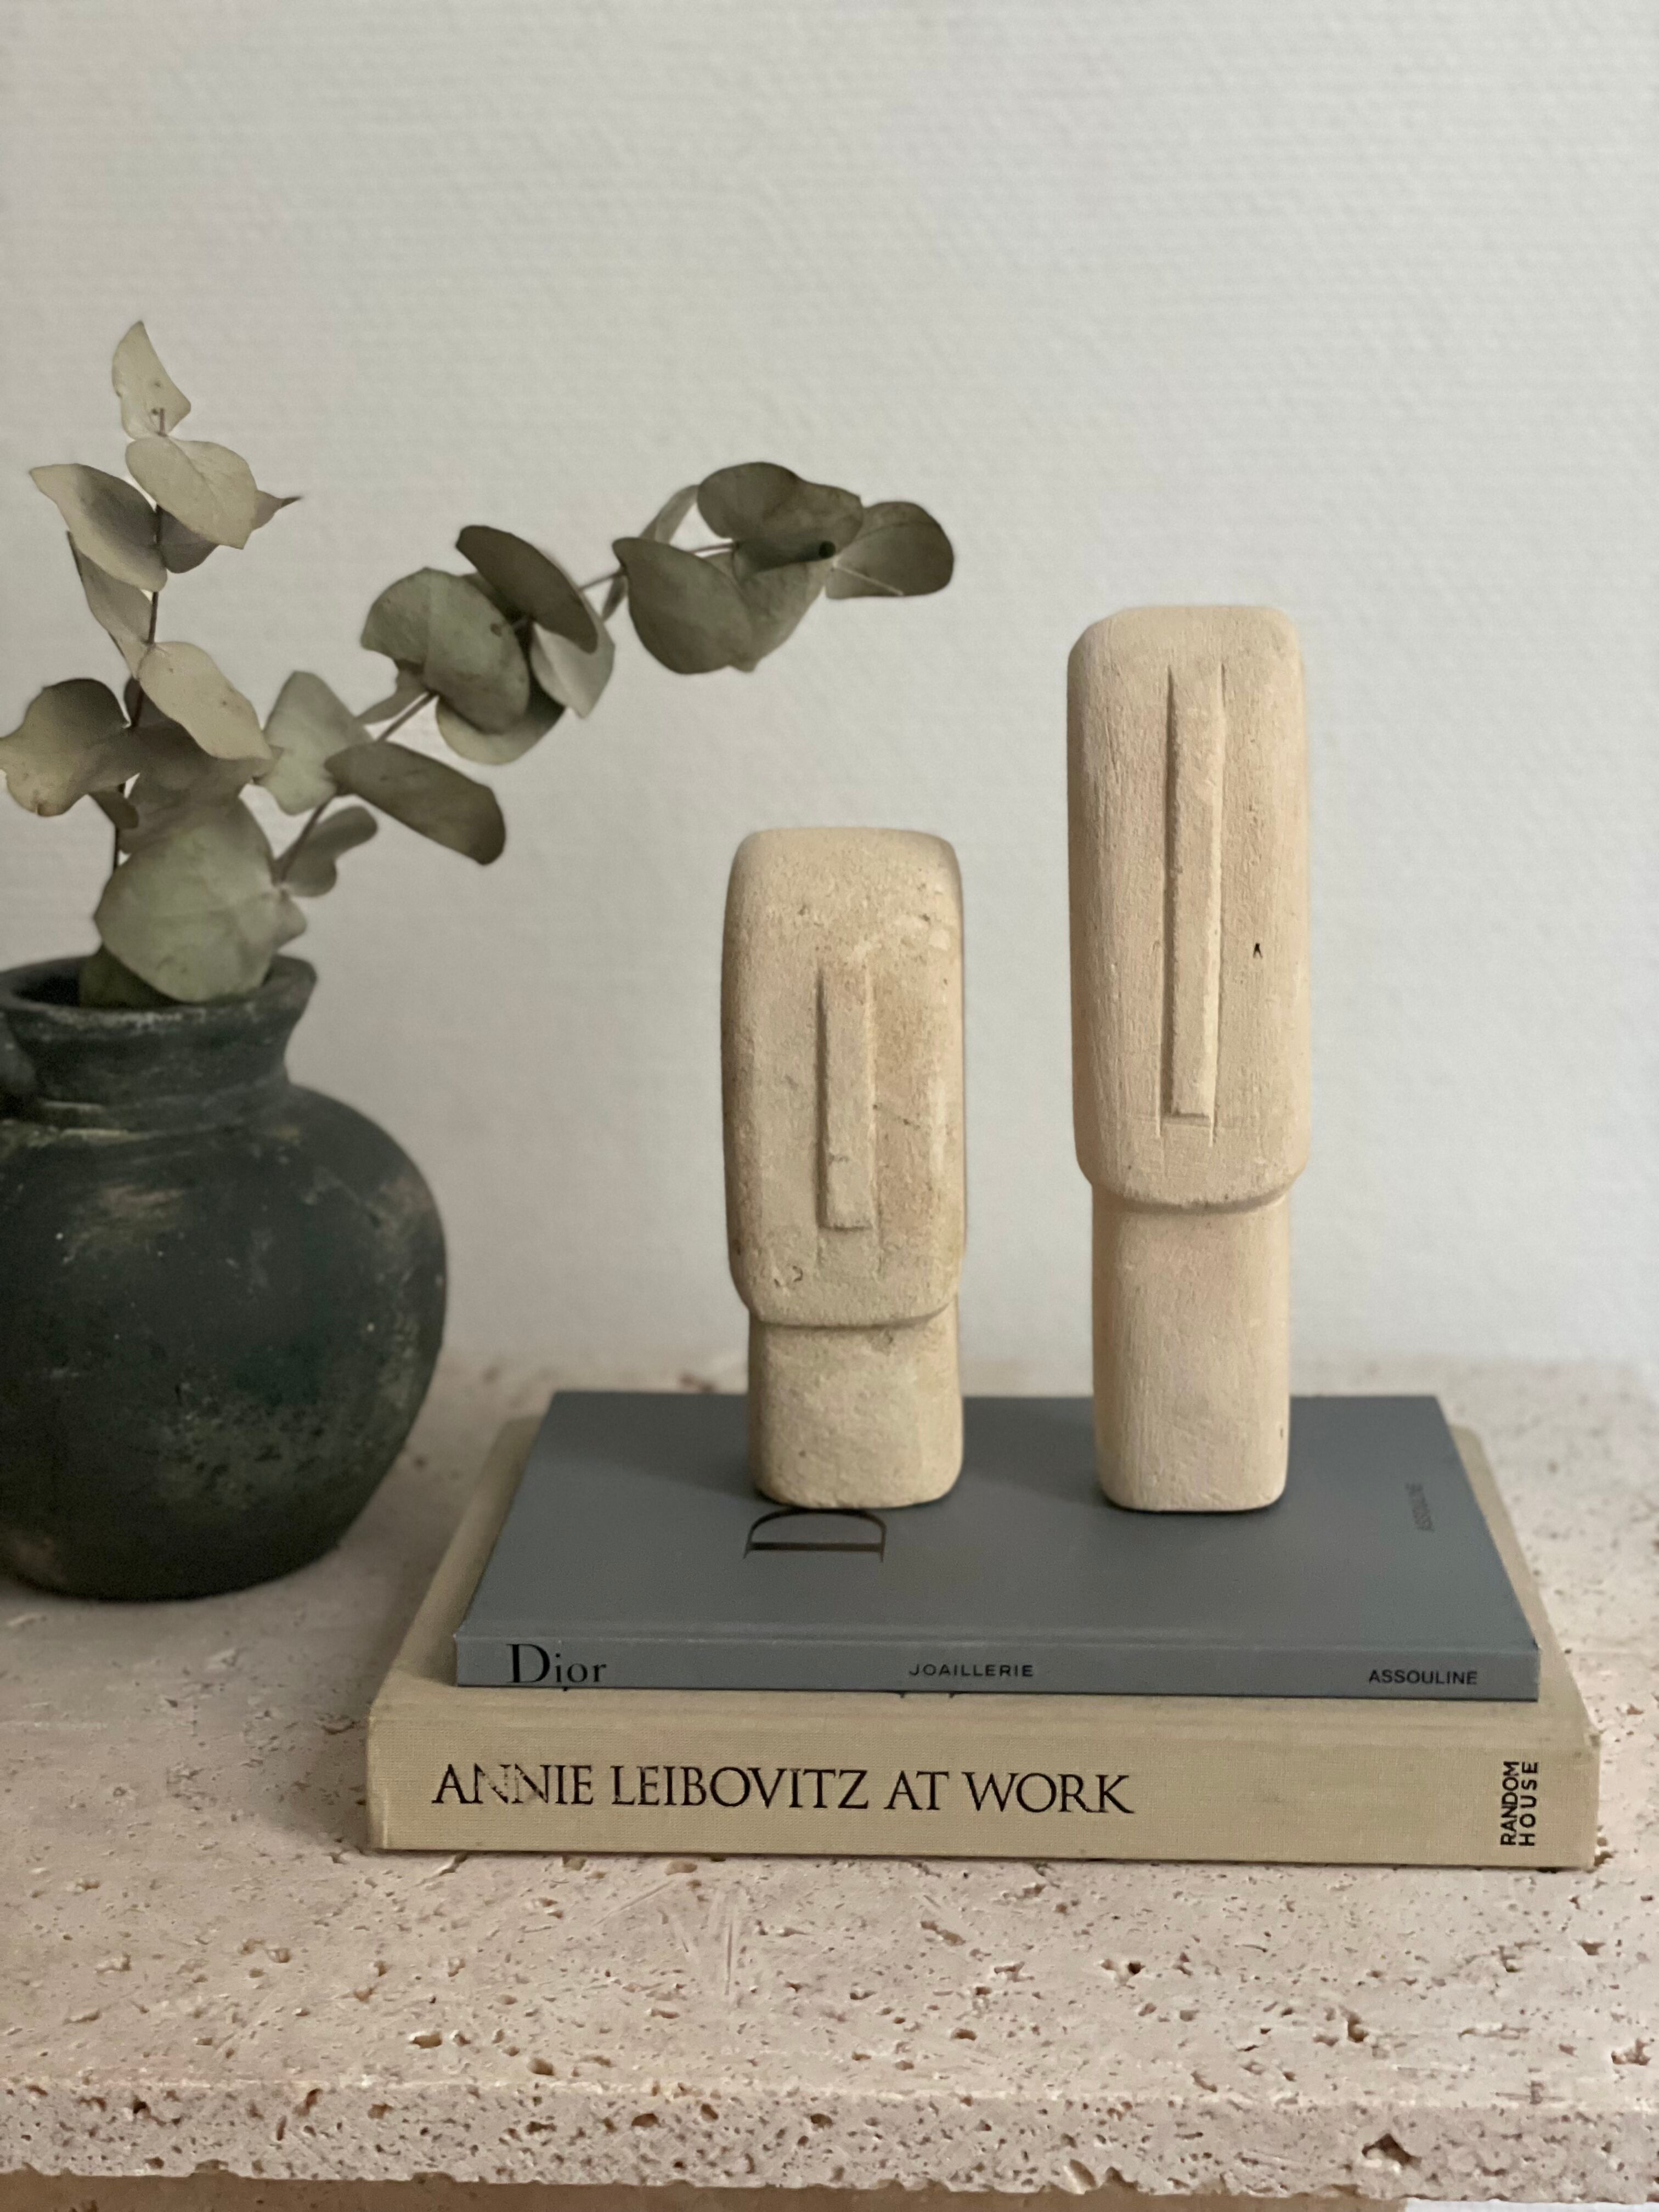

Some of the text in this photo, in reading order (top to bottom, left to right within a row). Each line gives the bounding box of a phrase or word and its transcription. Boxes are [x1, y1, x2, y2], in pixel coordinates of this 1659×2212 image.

[506, 1643, 607, 1684] Dior
[909, 1663, 1034, 1677] JOAILLERIE
[1368, 1669, 1477, 1685] ASSOULINE
[431, 1763, 1135, 1814] ANNIE LEIBOVITZ AT WORK
[1500, 1760, 1520, 1846] RANDOM
[1519, 1761, 1539, 1847] HOUSE
